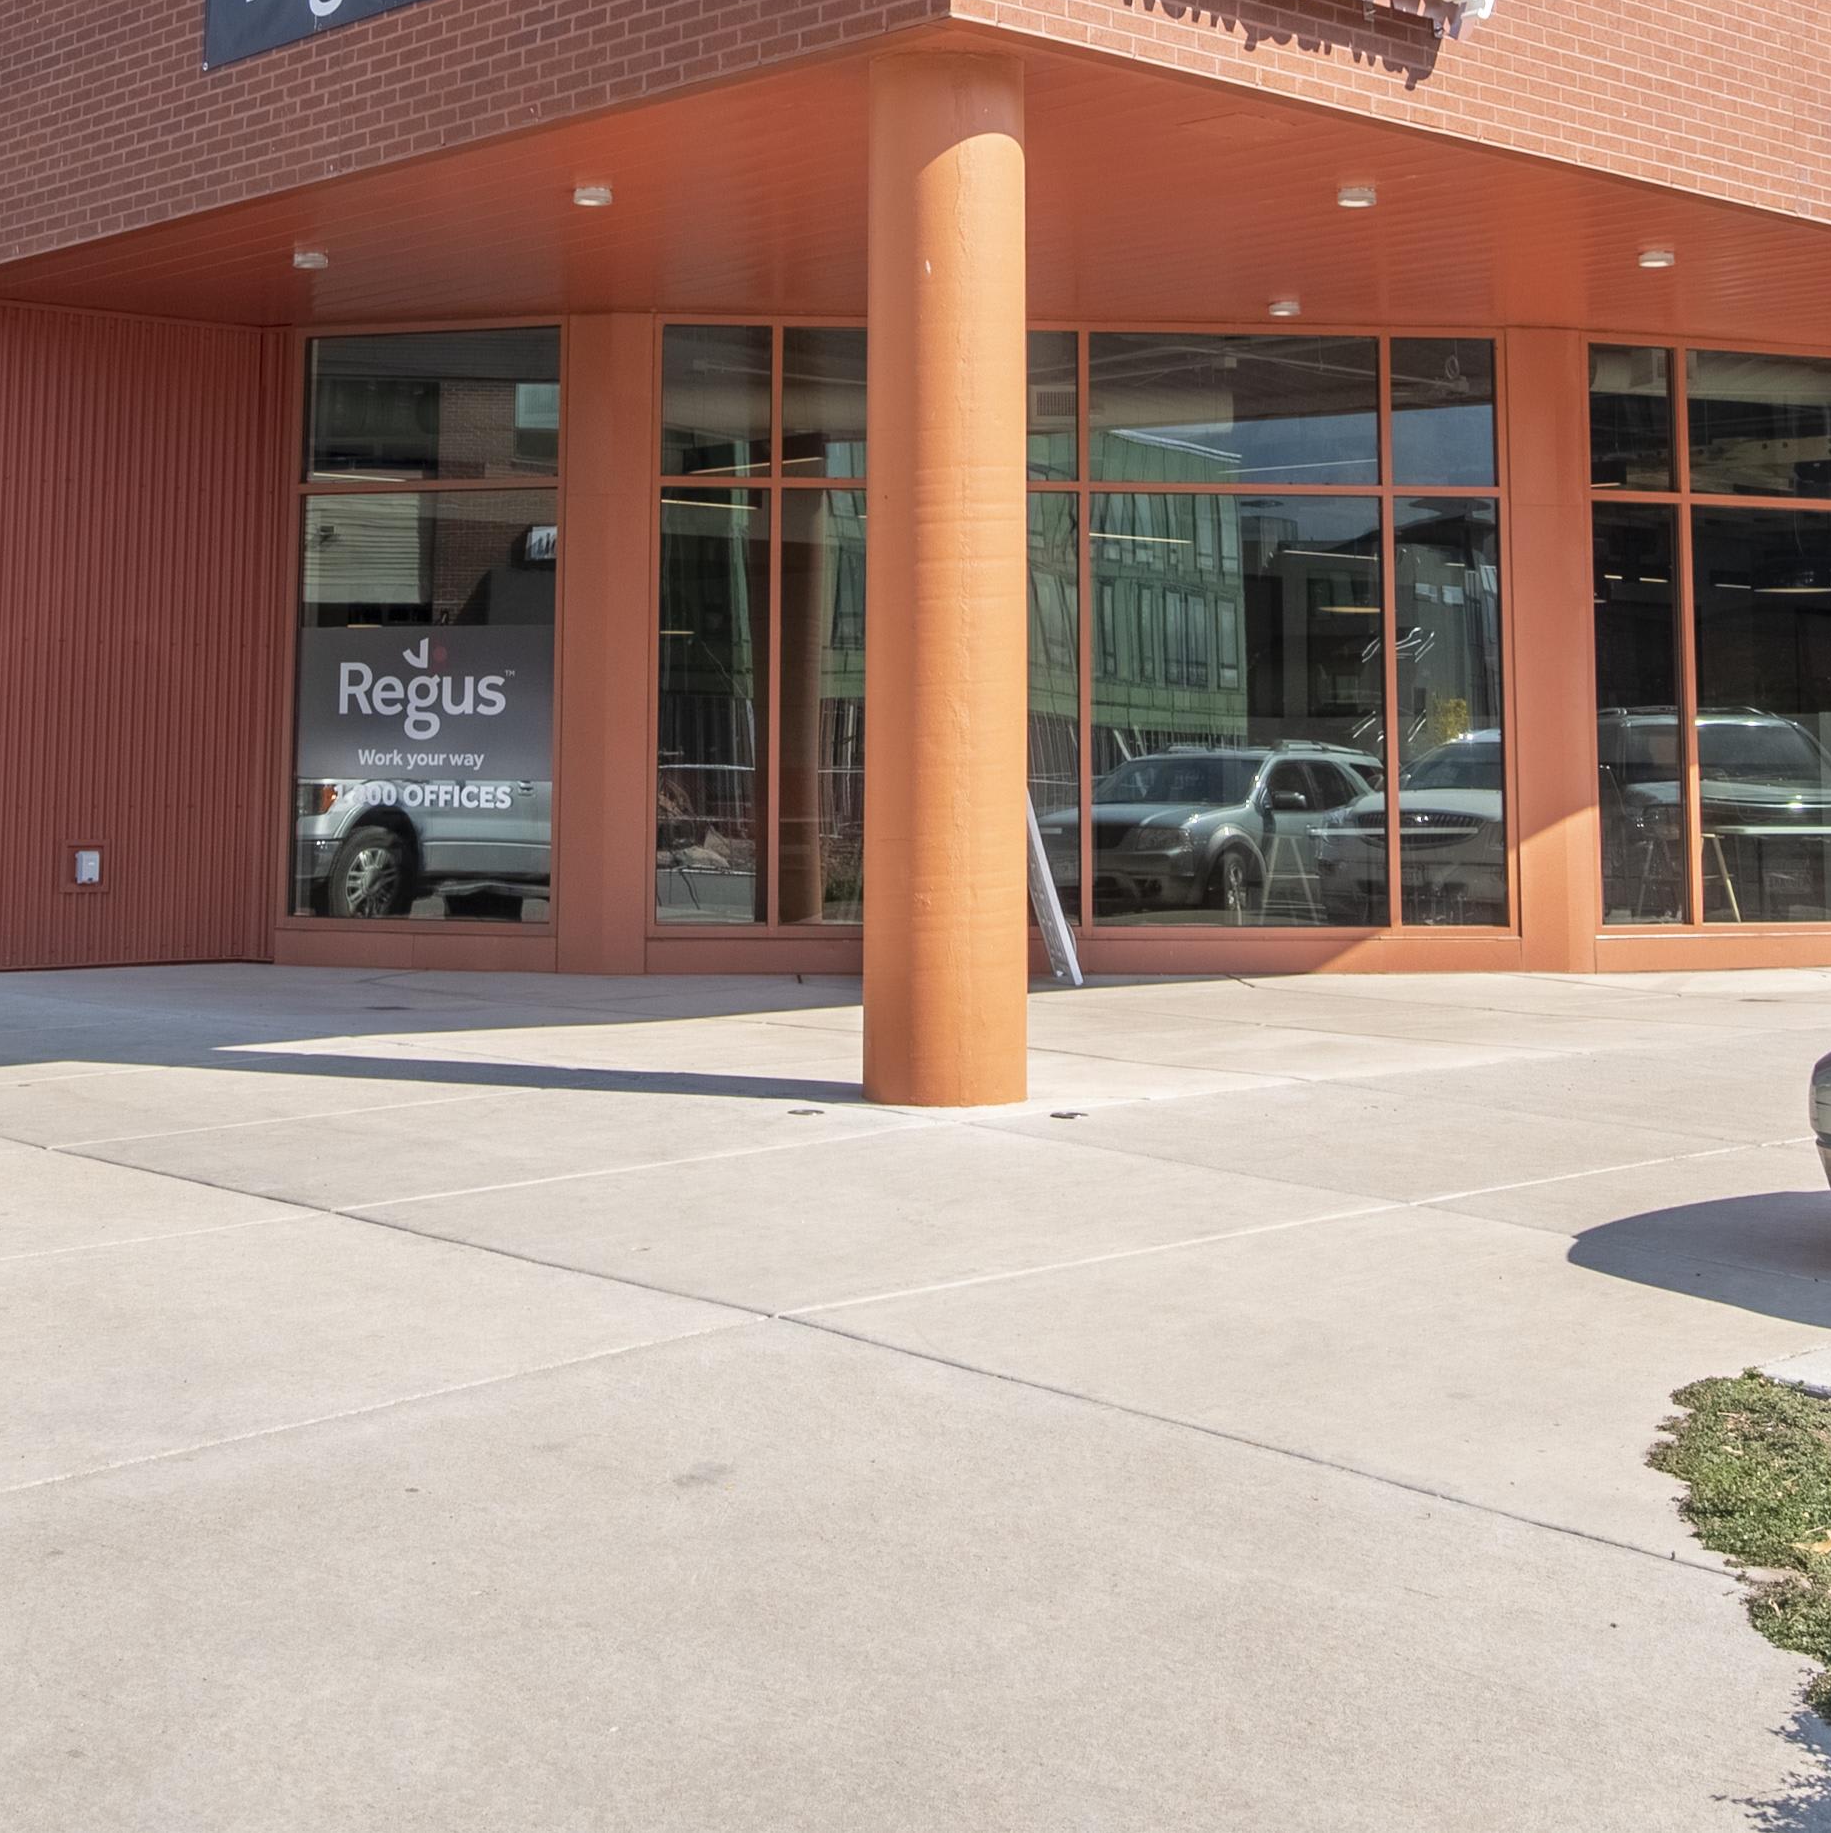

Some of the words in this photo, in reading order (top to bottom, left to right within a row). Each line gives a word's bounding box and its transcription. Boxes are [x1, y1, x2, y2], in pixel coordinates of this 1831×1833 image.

[338, 662, 507, 740] Regus
[358, 749, 402, 766] Work
[406, 752, 447, 770] your
[449, 753, 485, 770] way
[403, 784, 512, 809] OFFICES
